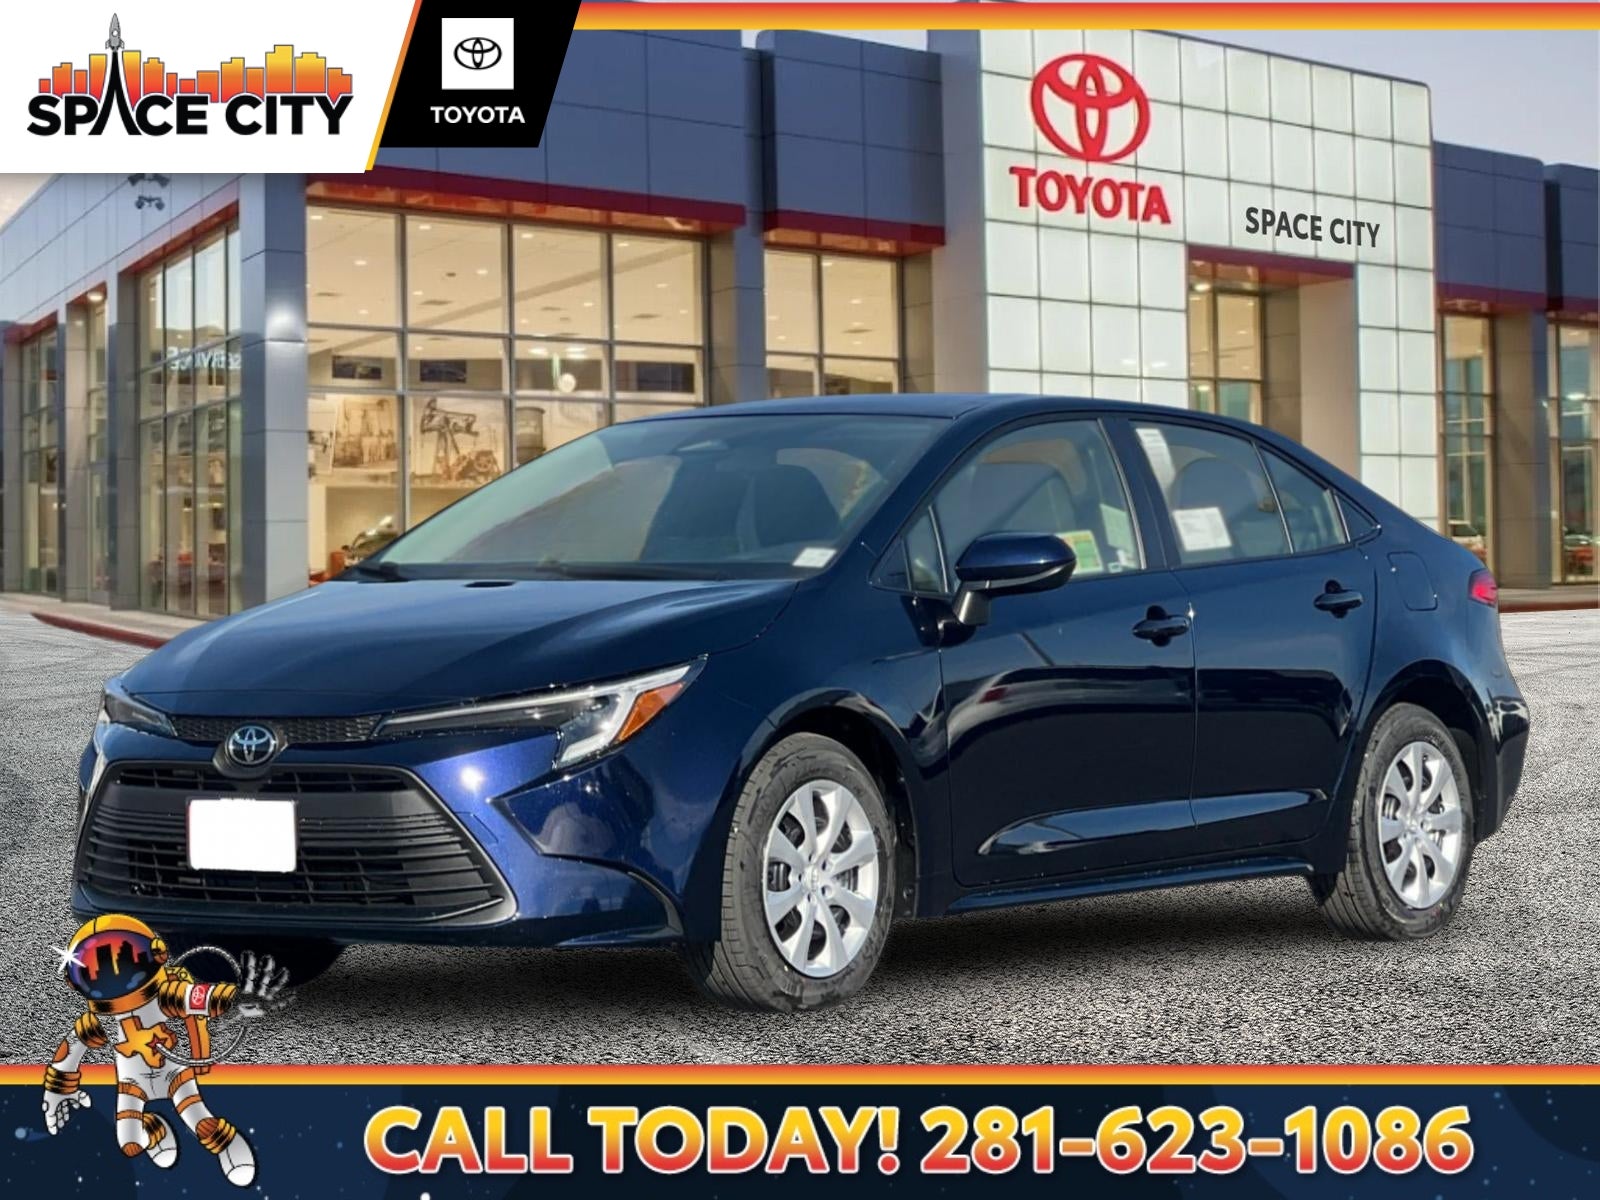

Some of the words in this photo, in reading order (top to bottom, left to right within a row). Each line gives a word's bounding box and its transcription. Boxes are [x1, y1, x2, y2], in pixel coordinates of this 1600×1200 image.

[1009, 166, 1171, 224] TOYOTA
[1245, 206, 1322, 242] SPACE
[1329, 217, 1381, 248] CITY
